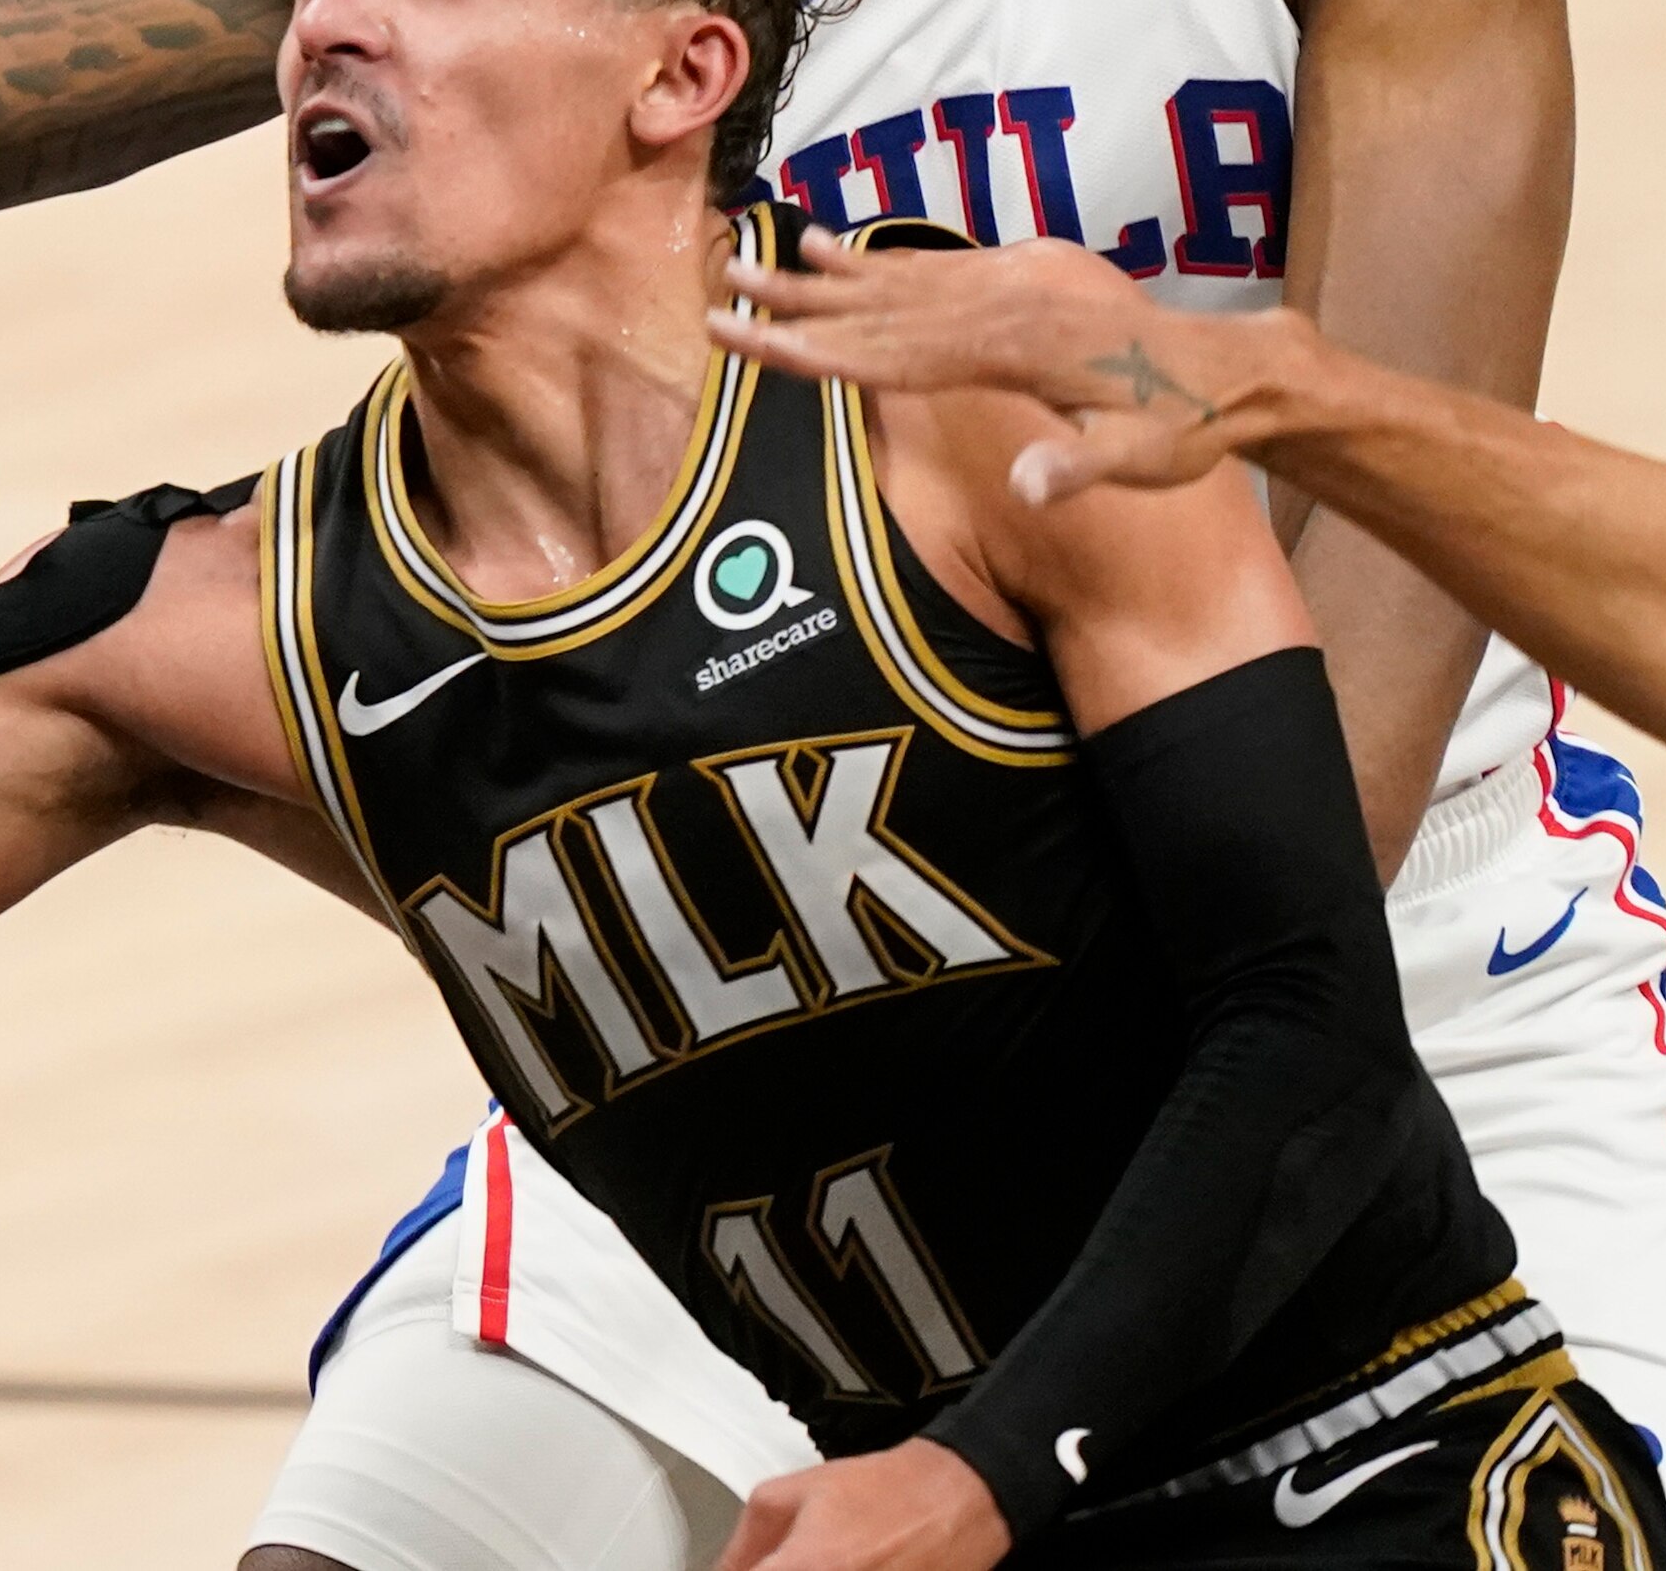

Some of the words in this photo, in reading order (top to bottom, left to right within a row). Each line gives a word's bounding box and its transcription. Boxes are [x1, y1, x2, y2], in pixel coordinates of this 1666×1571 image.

[729, 78, 1294, 282] HILA
[694, 607, 839, 692] sharecare
[401, 725, 1061, 1138] MLK
[701, 1142, 995, 1406] 11
